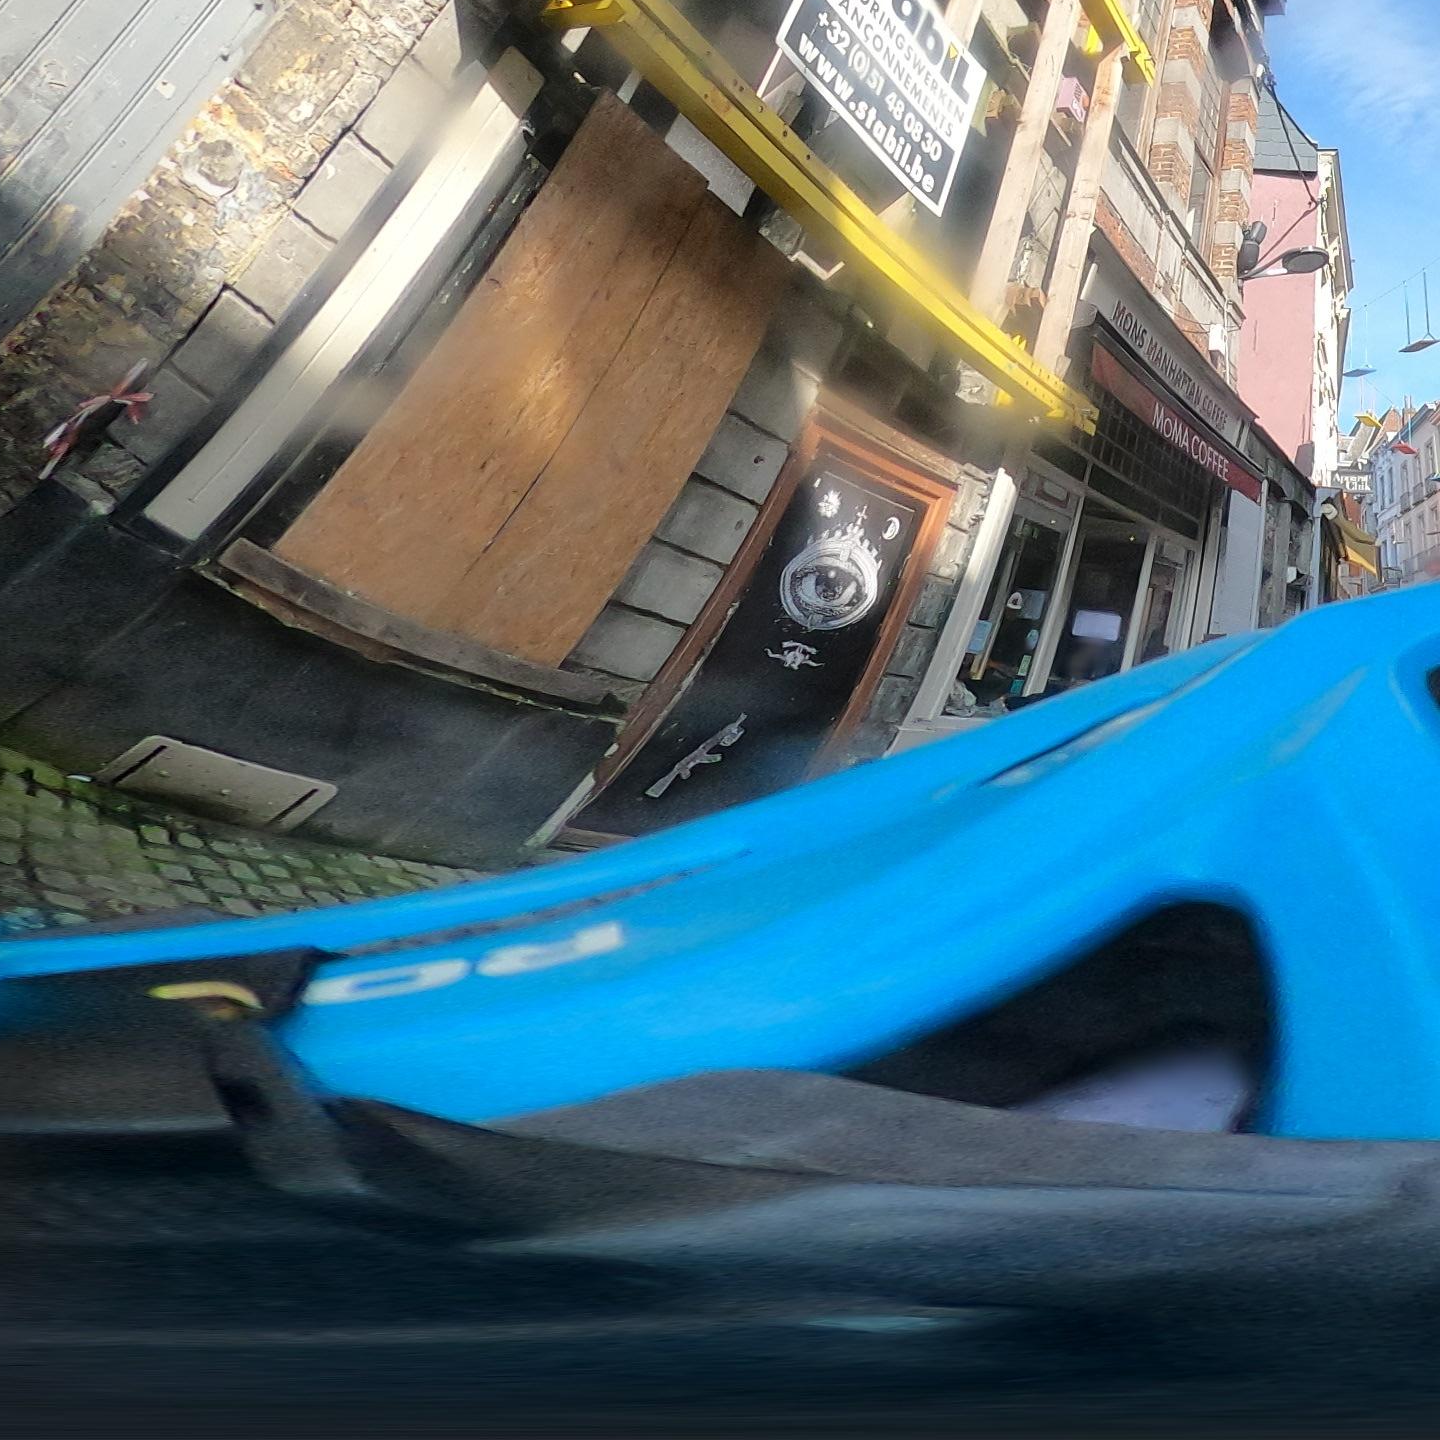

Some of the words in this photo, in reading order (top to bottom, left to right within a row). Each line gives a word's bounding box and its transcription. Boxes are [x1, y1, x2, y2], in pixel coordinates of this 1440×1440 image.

[798, 32, 936, 193] www.stabil.be
[817, 12, 851, 56] +32
[884, 91, 905, 122] 48
[903, 111, 924, 143] 08
[920, 130, 943, 162] 30
[1111, 300, 1148, 348] MONS
[1145, 337, 1203, 409] MANHATTAN
[1190, 434, 1231, 483] COFFEE
